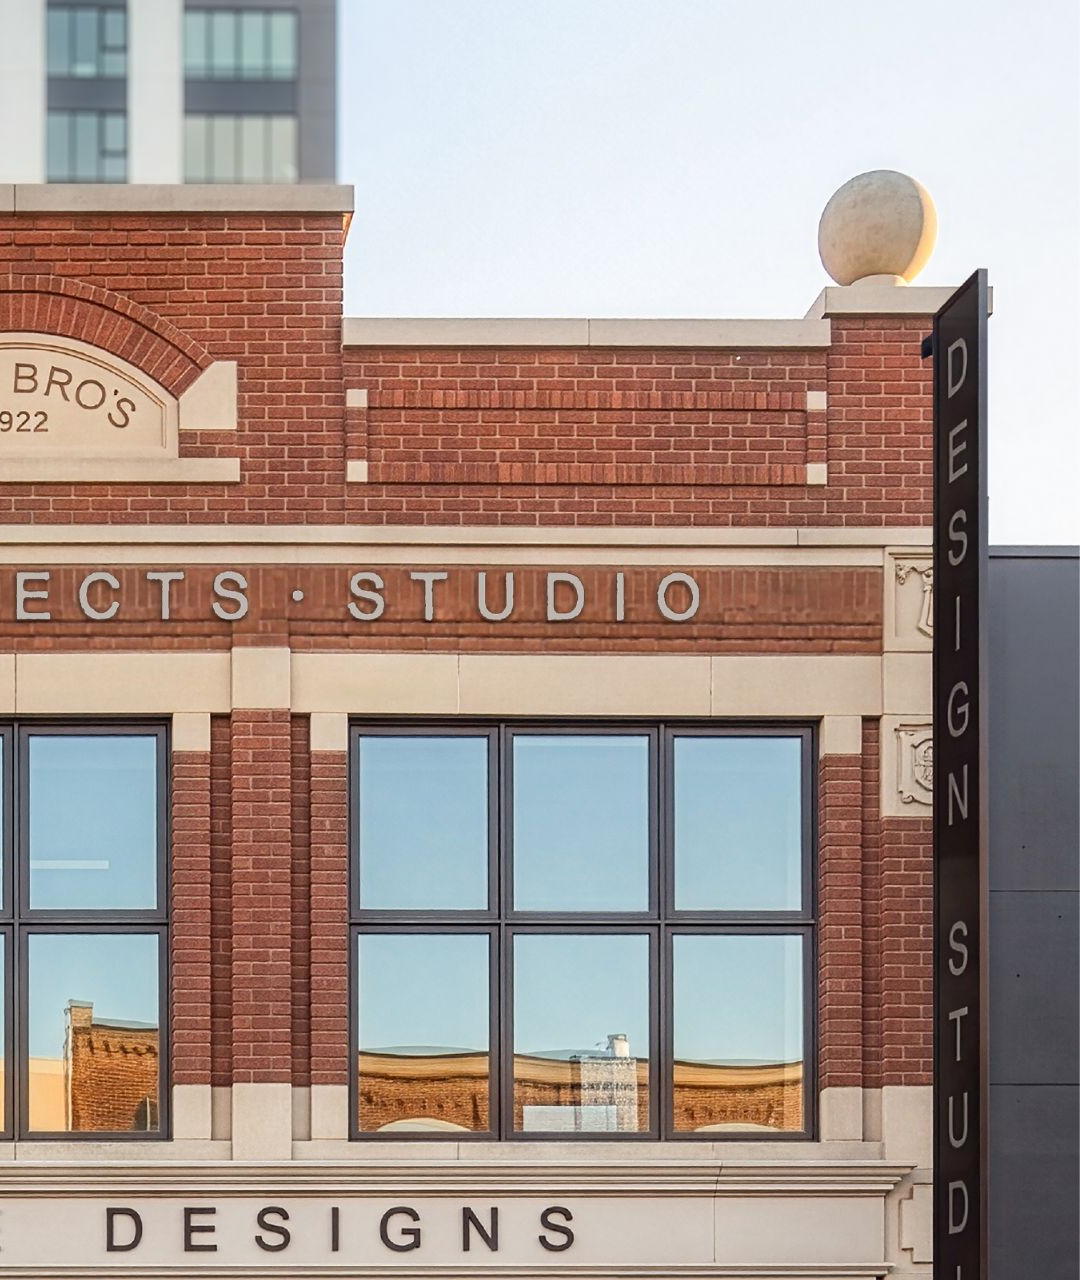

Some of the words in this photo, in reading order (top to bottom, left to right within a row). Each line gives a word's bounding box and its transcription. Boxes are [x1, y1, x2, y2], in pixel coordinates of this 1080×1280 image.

[13, 363, 137, 429] BRO'S
[347, 570, 701, 621] STUDIO
[947, 336, 970, 827] DESIGN
[106, 1206, 576, 1254] DESIGNS
